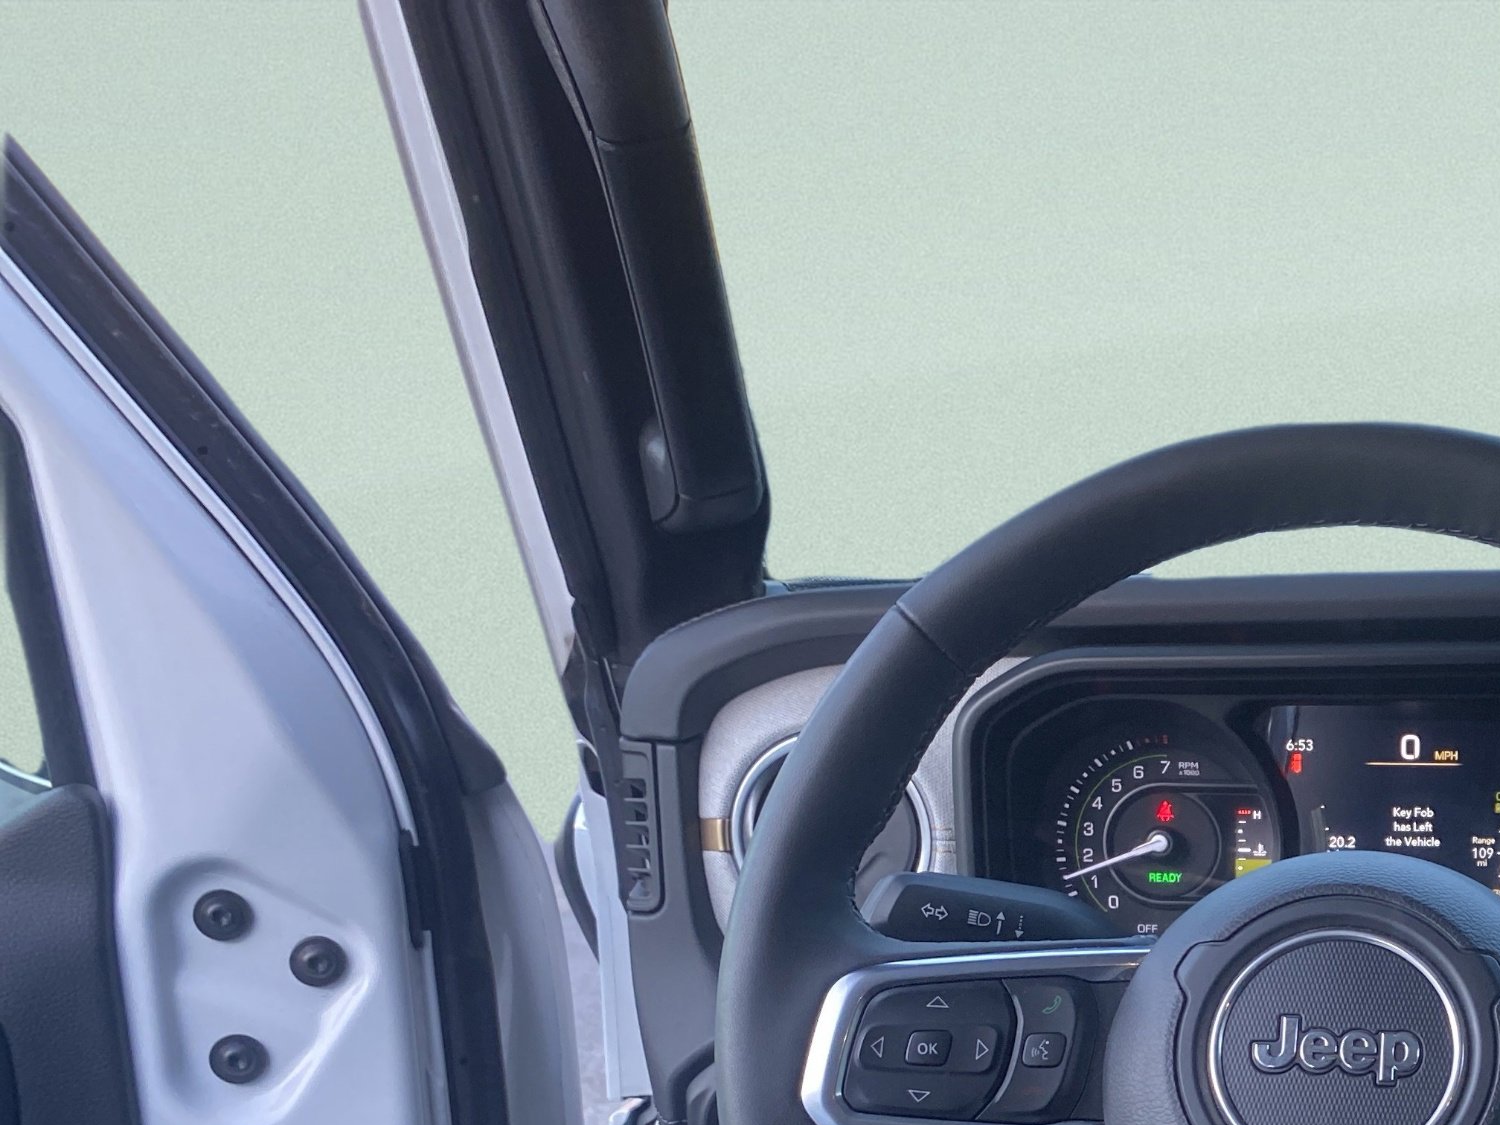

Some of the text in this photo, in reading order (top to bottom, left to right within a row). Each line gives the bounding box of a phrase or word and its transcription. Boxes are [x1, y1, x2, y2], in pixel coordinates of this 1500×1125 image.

[1286, 738, 1314, 752] 6:53
[1400, 734, 1459, 762] 0 MPH
[1133, 765, 1144, 779] 6
[1160, 760, 1171, 774] 7
[1178, 761, 1199, 770] RPM
[1111, 778, 1122, 792] 5
[1092, 796, 1103, 810] 4
[1253, 810, 1262, 820] H
[1392, 806, 1434, 819] Key Fob
[1083, 822, 1094, 836] 3
[1393, 822, 1433, 833] has Left
[1328, 836, 1356, 849] 20.2
[1385, 836, 1441, 848] the Vehicle
[1471, 836, 1496, 847] Range
[1083, 848, 1094, 863] 2
[1471, 847, 1495, 859] 109
[1476, 859, 1488, 867] mi
[1090, 875, 1099, 889] 1
[1148, 872, 1183, 884] READY
[1108, 895, 1119, 909] 0
[1137, 923, 1159, 934] OFF
[917, 1042, 938, 1056] OK
[1251, 1013, 1423, 1086] Jeep
